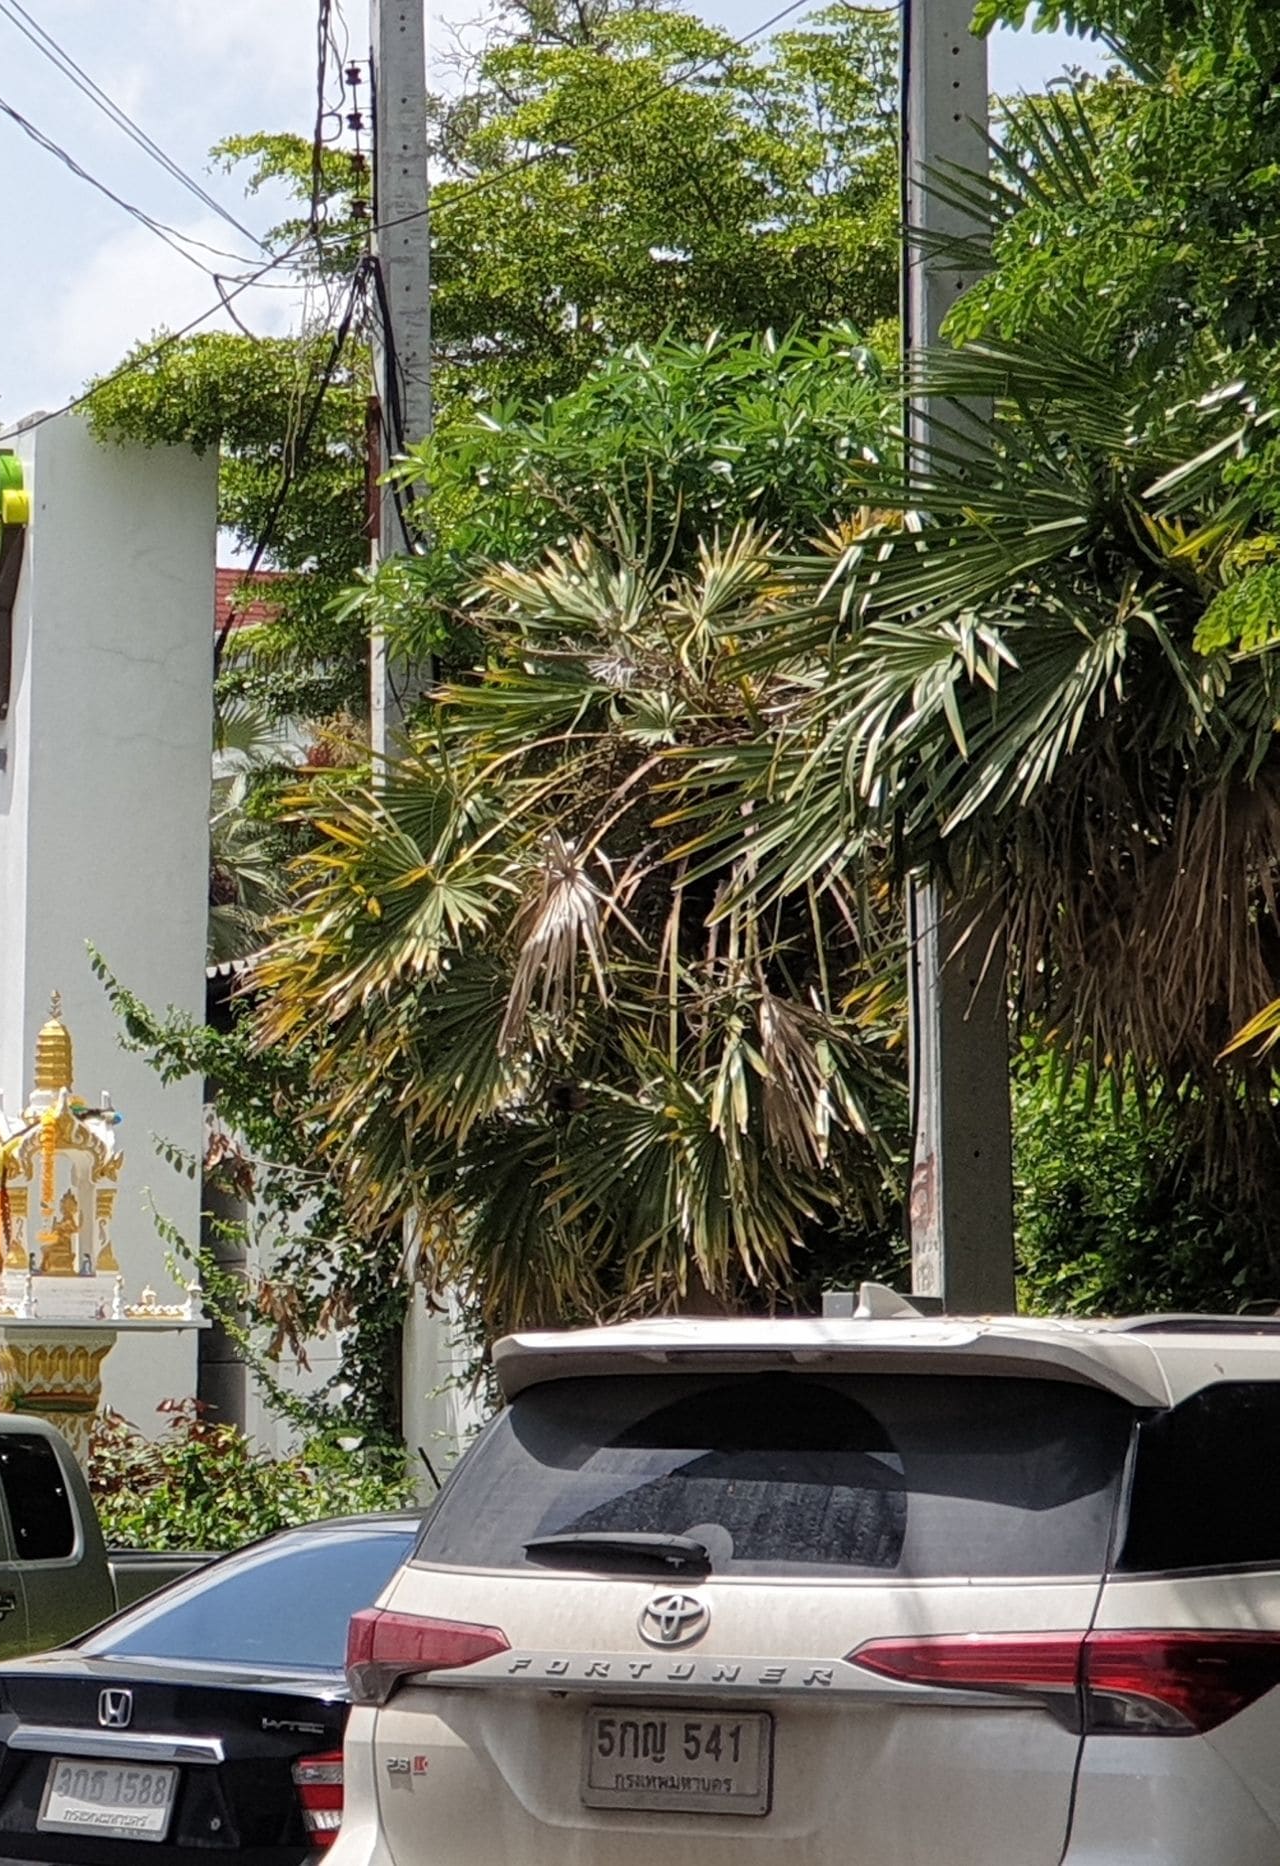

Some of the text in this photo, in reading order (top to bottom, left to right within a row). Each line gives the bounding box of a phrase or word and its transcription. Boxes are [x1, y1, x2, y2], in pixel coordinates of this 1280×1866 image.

[508, 1658, 834, 1687] FORTUNER
[597, 1719, 743, 1763] 5กญ 541
[114, 1771, 167, 1805] 1588
